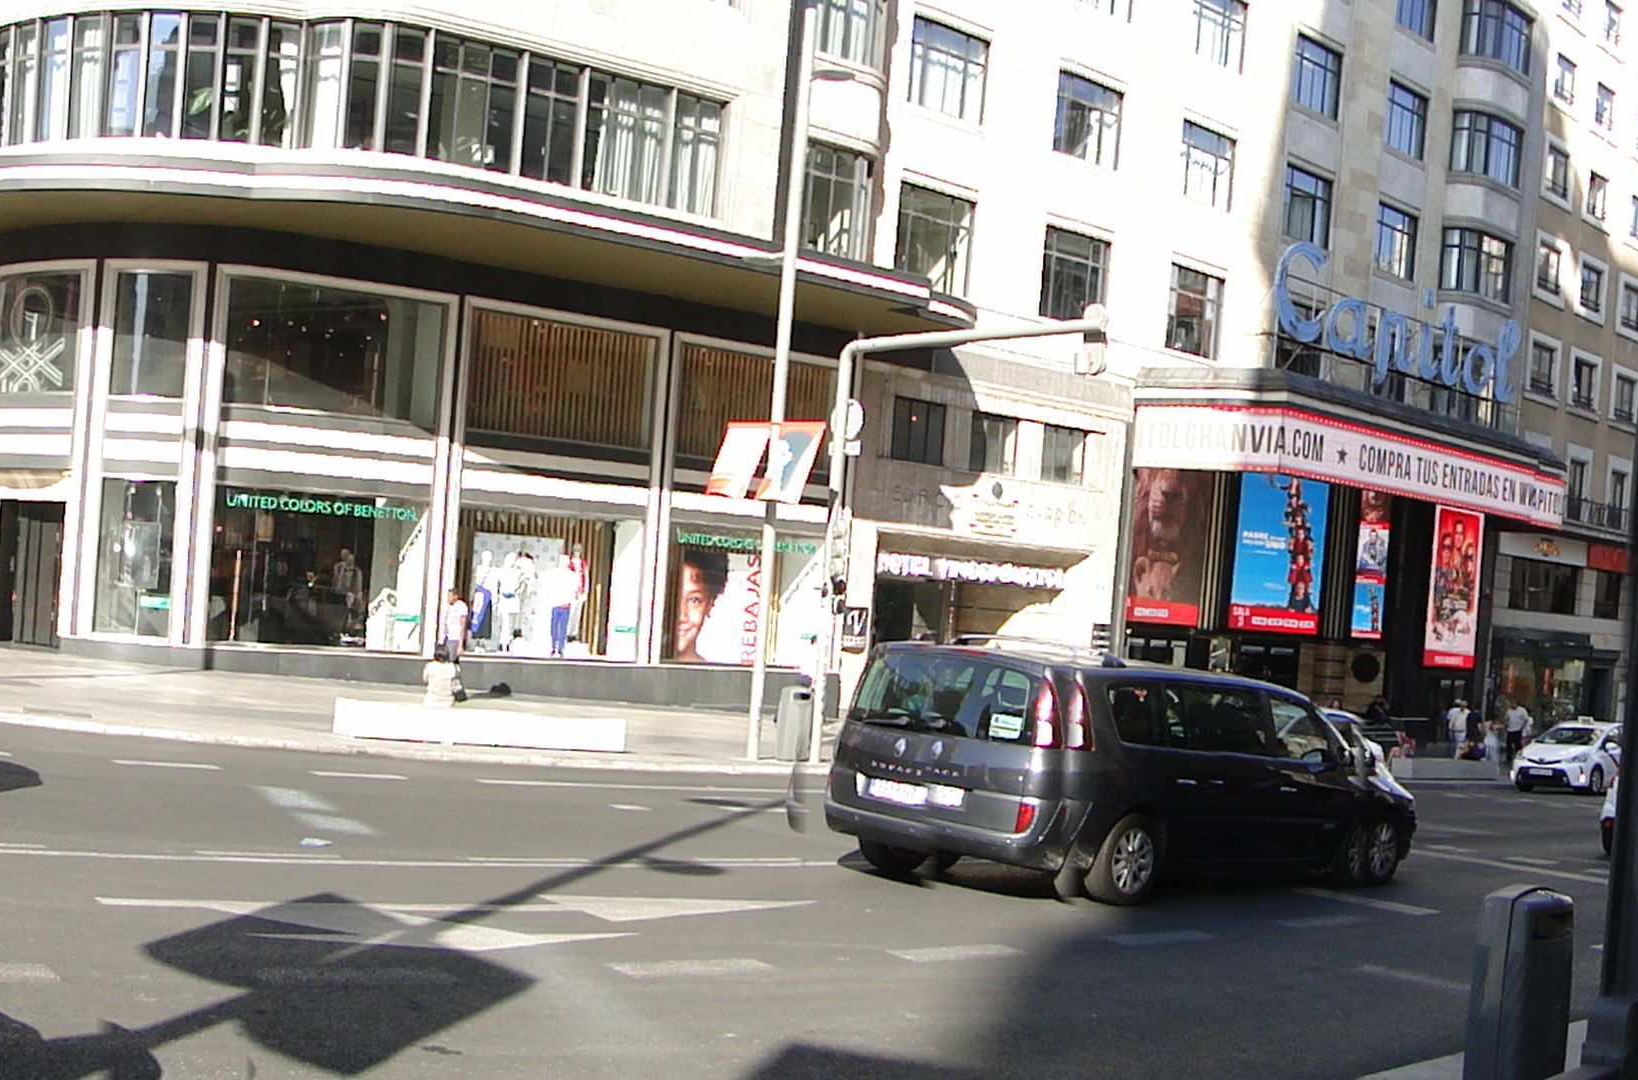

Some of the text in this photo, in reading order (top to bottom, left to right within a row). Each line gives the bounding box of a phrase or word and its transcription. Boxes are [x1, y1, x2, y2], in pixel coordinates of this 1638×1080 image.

[1274, 240, 1522, 402] Capitol
[226, 490, 419, 522] UNITED COLORS OF BENETTON
[1359, 444, 1411, 482] COMPRA
[1416, 456, 1438, 487] TUS
[1442, 463, 1499, 500] ENTRADAS
[1502, 472, 1516, 501] EN
[740, 552, 762, 665] REBAJAS
